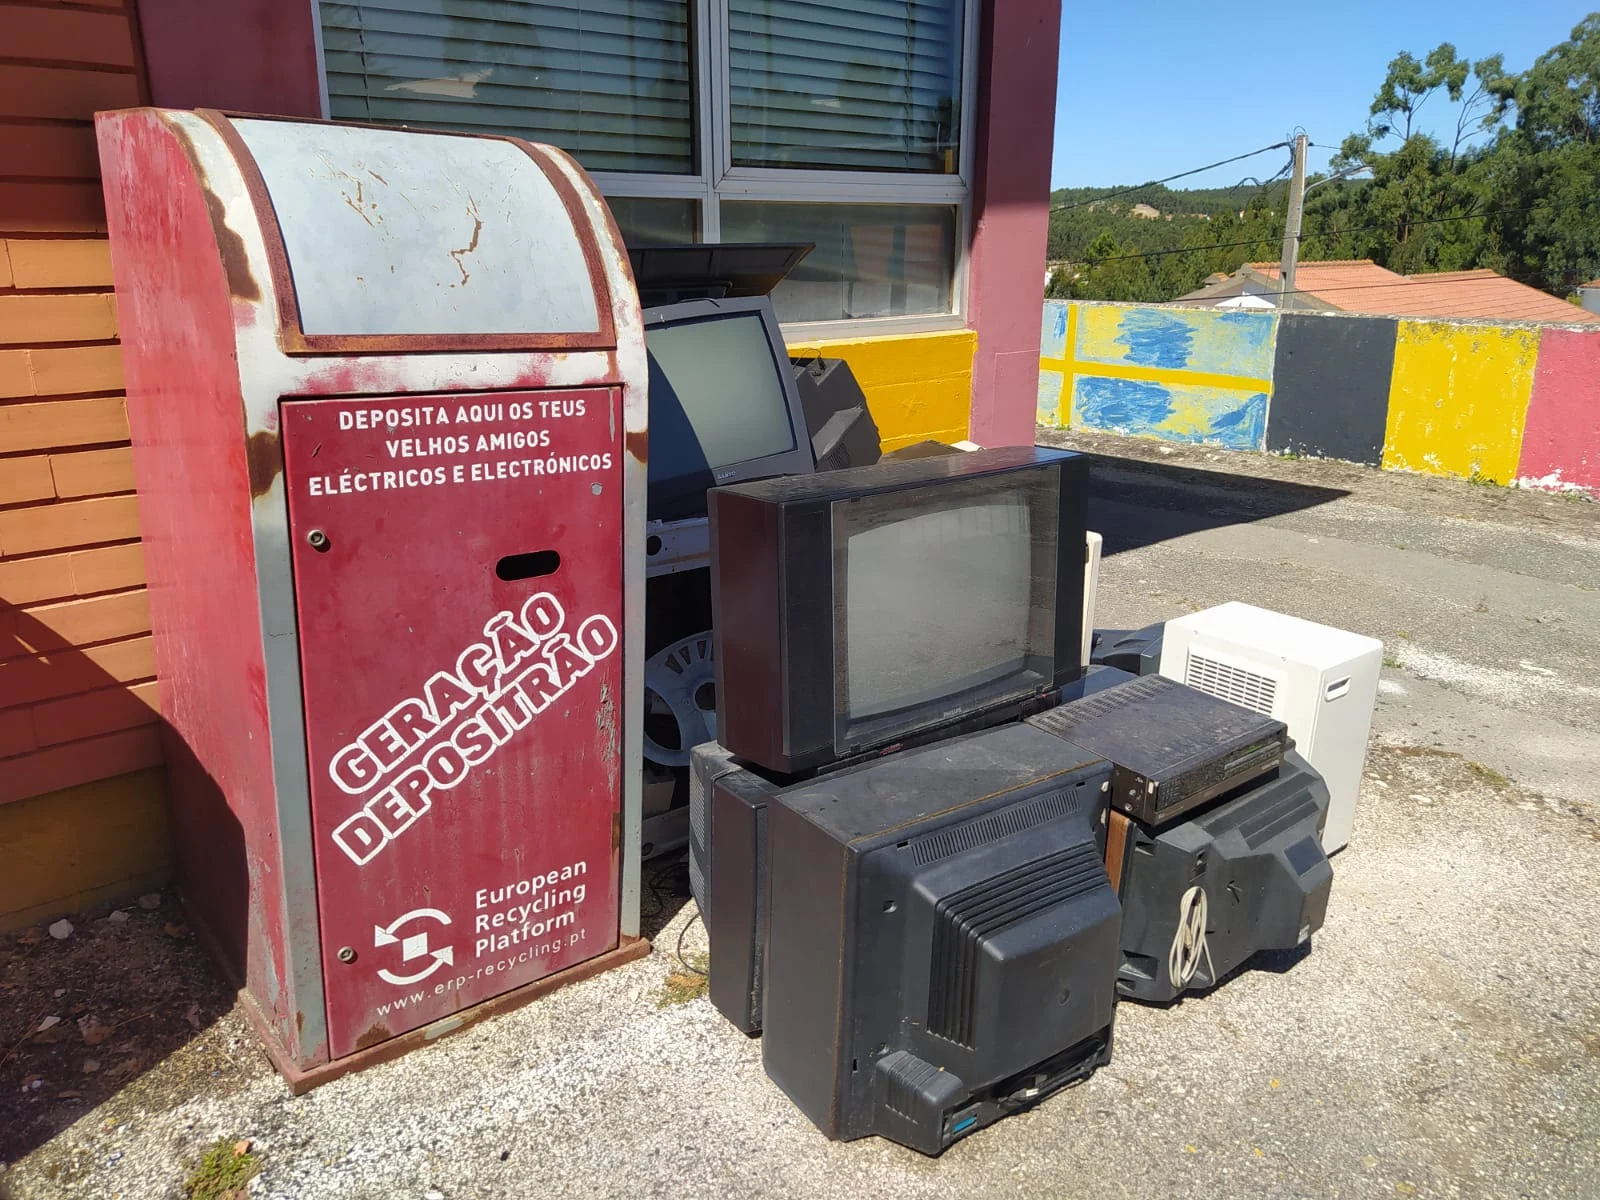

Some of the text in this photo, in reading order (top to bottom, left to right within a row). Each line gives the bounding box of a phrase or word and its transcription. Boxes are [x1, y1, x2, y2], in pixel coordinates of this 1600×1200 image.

[339, 399, 586, 431] DEPOSITA AQUI OS TEUS
[385, 429, 551, 459] VELHOS AMIGOS
[309, 451, 613, 497] ELÉCTRICOS E ELECTRÓNICOS
[329, 591, 565, 794] GERAÇÃO
[331, 613, 618, 866] DEPOSITRÃO
[475, 861, 587, 910] European
[475, 883, 587, 934] Recycling
[475, 911, 575, 959] Platform
[376, 927, 587, 1017] www.erp-recycling.pt
